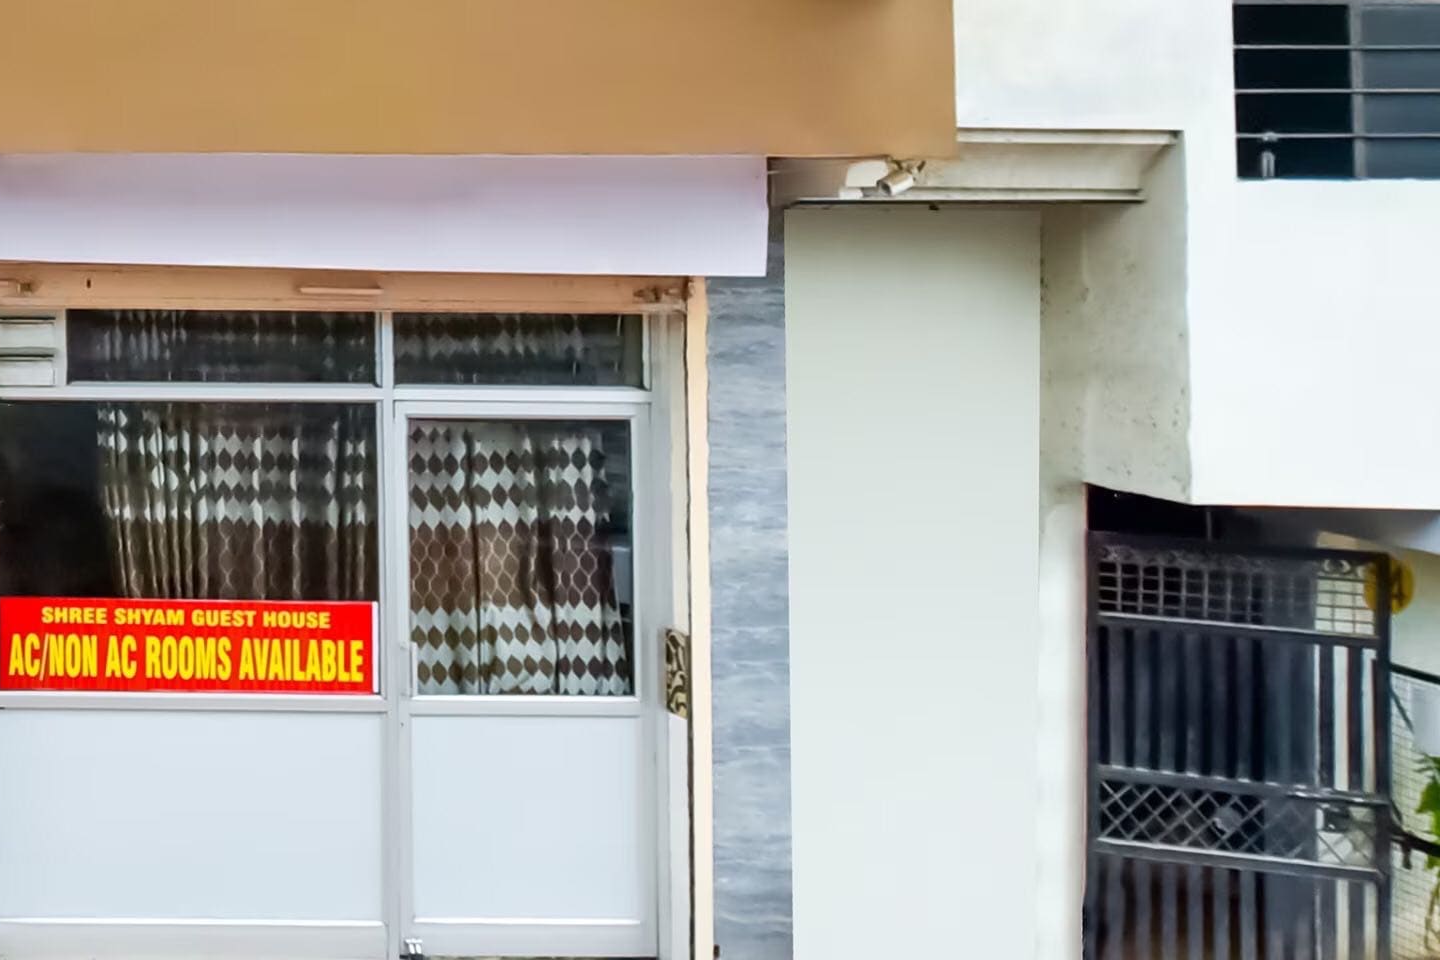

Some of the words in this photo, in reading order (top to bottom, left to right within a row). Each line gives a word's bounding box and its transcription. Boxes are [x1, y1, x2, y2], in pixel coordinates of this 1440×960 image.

[41, 606, 108, 624] SHREE
[114, 607, 185, 625] SHYAM
[191, 609, 257, 627] GUEST
[262, 611, 331, 629] HOUSE
[8, 632, 98, 681] AC/NON
[105, 634, 137, 679] AC
[145, 636, 232, 680] ROOMS
[239, 637, 364, 683] AVAILABLE
